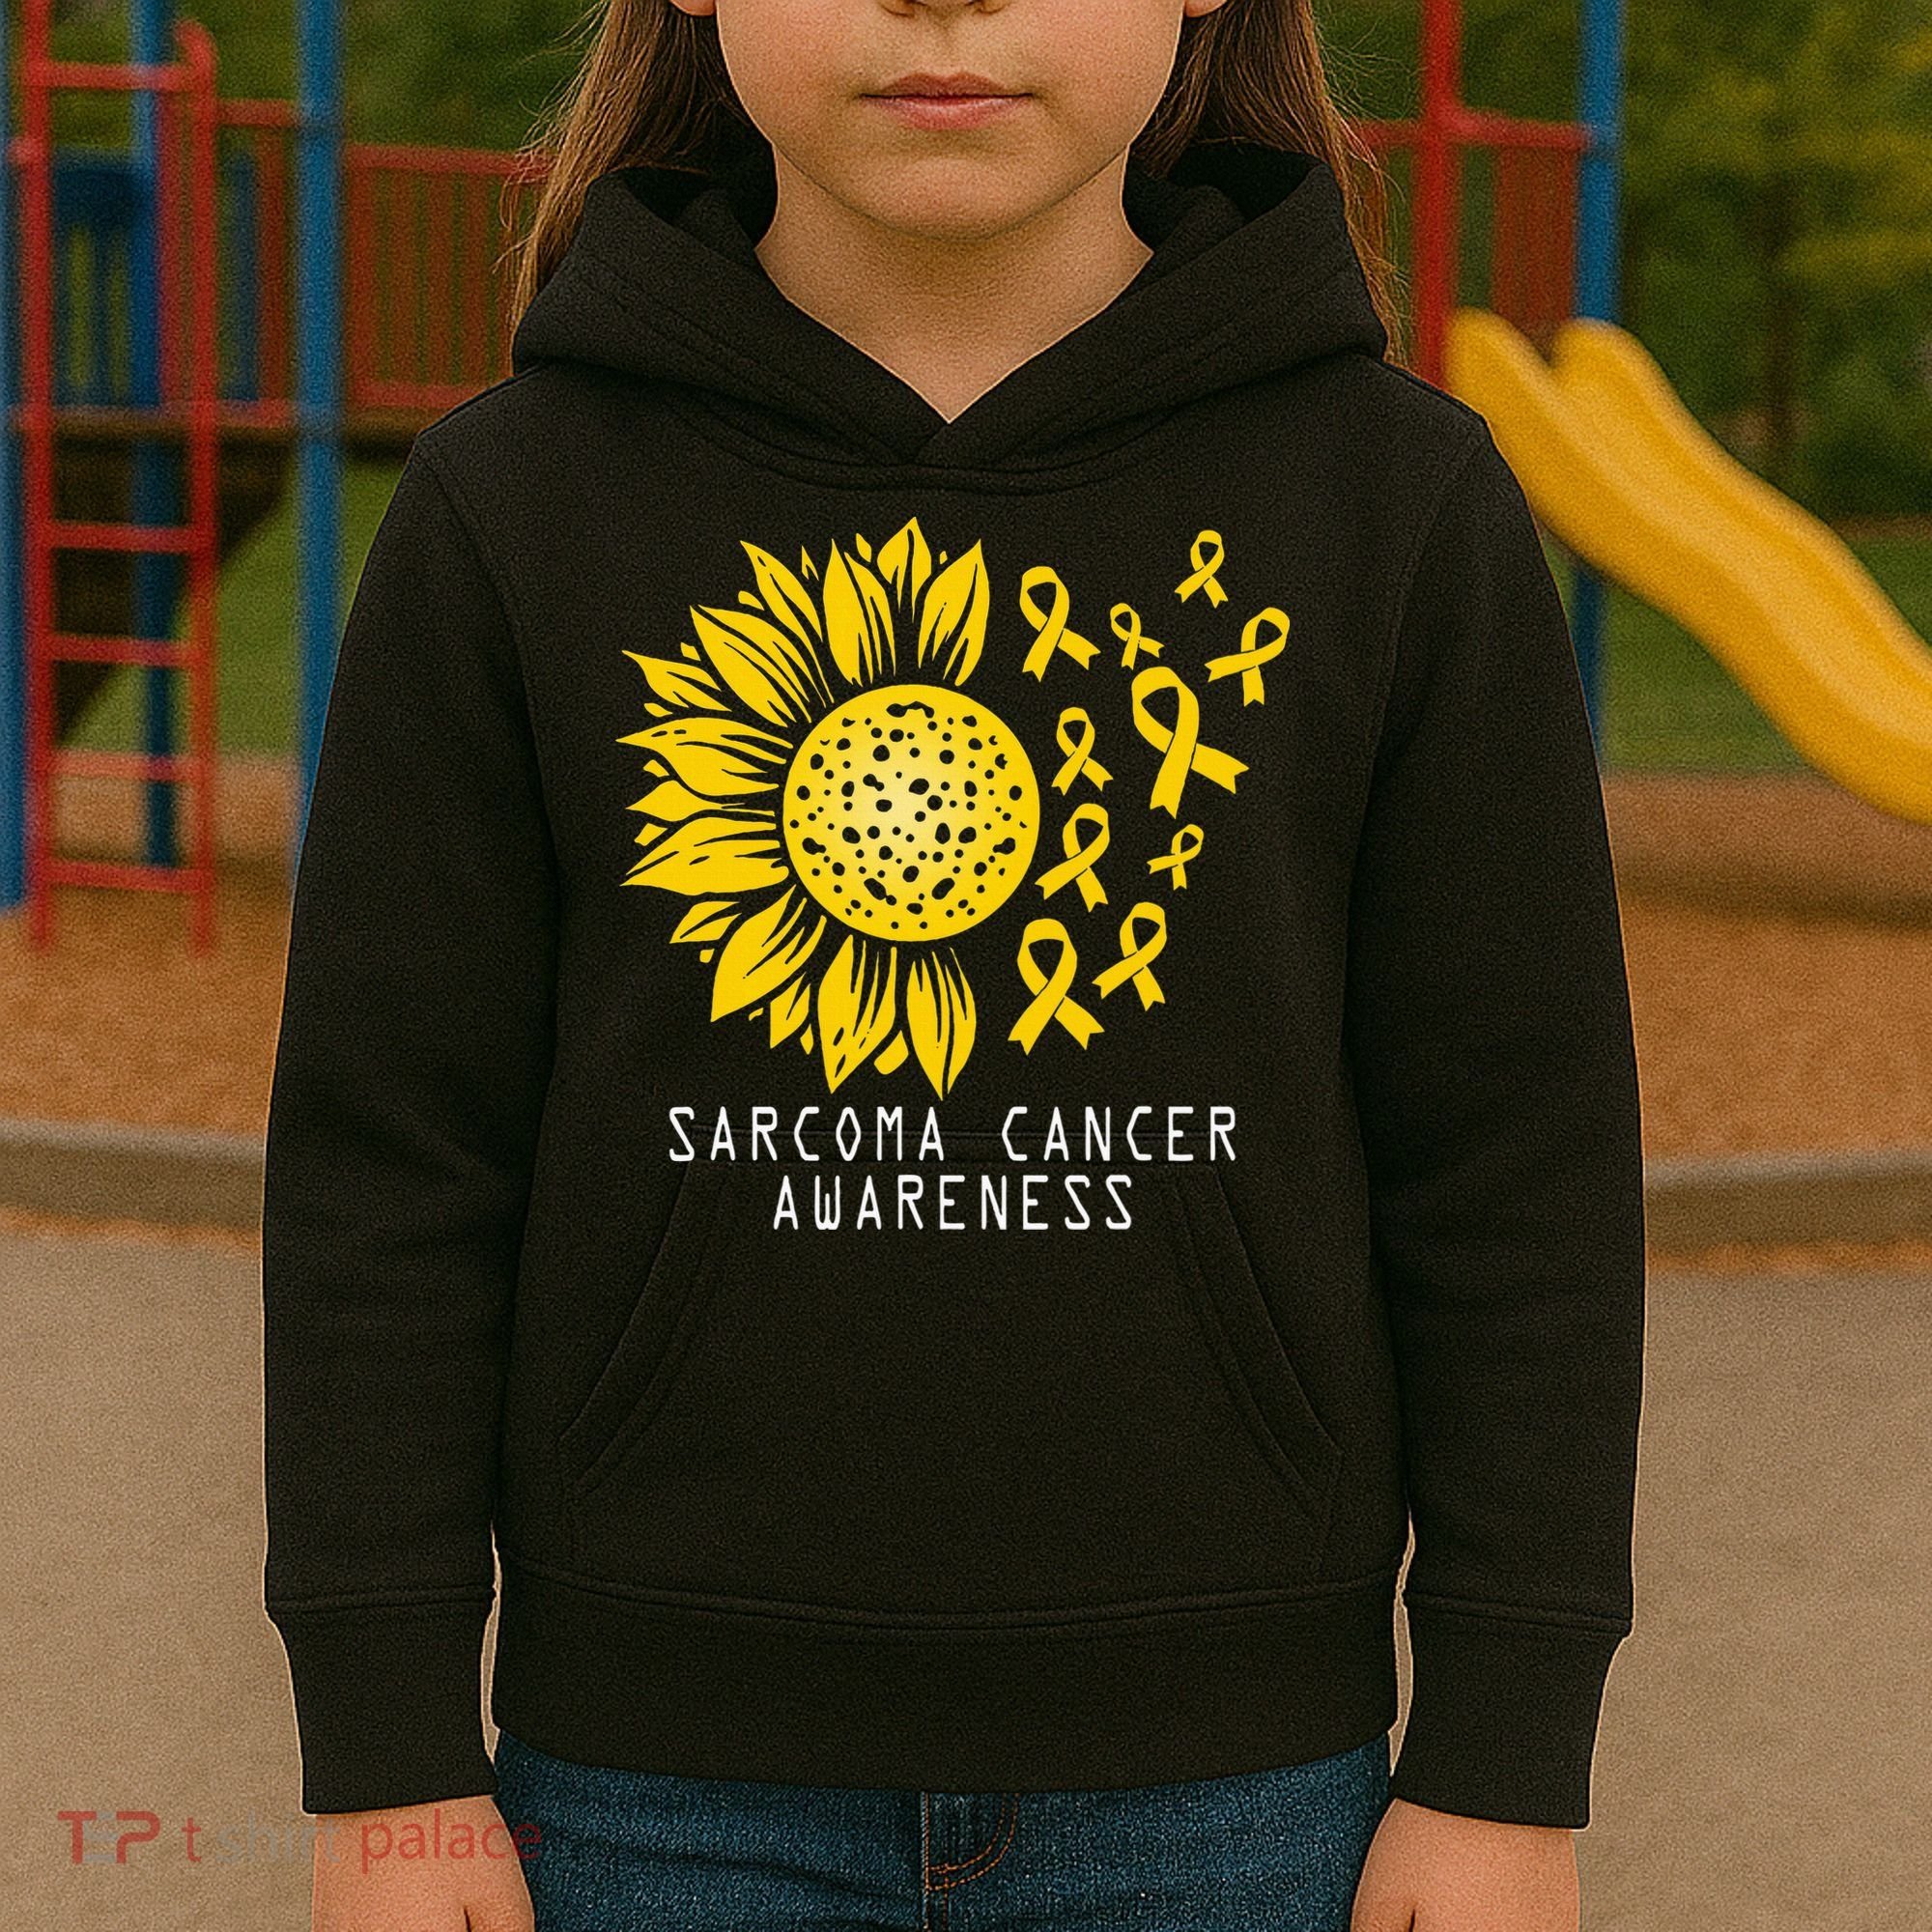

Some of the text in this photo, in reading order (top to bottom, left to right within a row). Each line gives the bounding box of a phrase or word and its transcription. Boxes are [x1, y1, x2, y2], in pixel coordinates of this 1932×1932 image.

[668, 1105, 1236, 1161] SARCOMA CANCER
[773, 1174, 1131, 1230] AWARENESS
